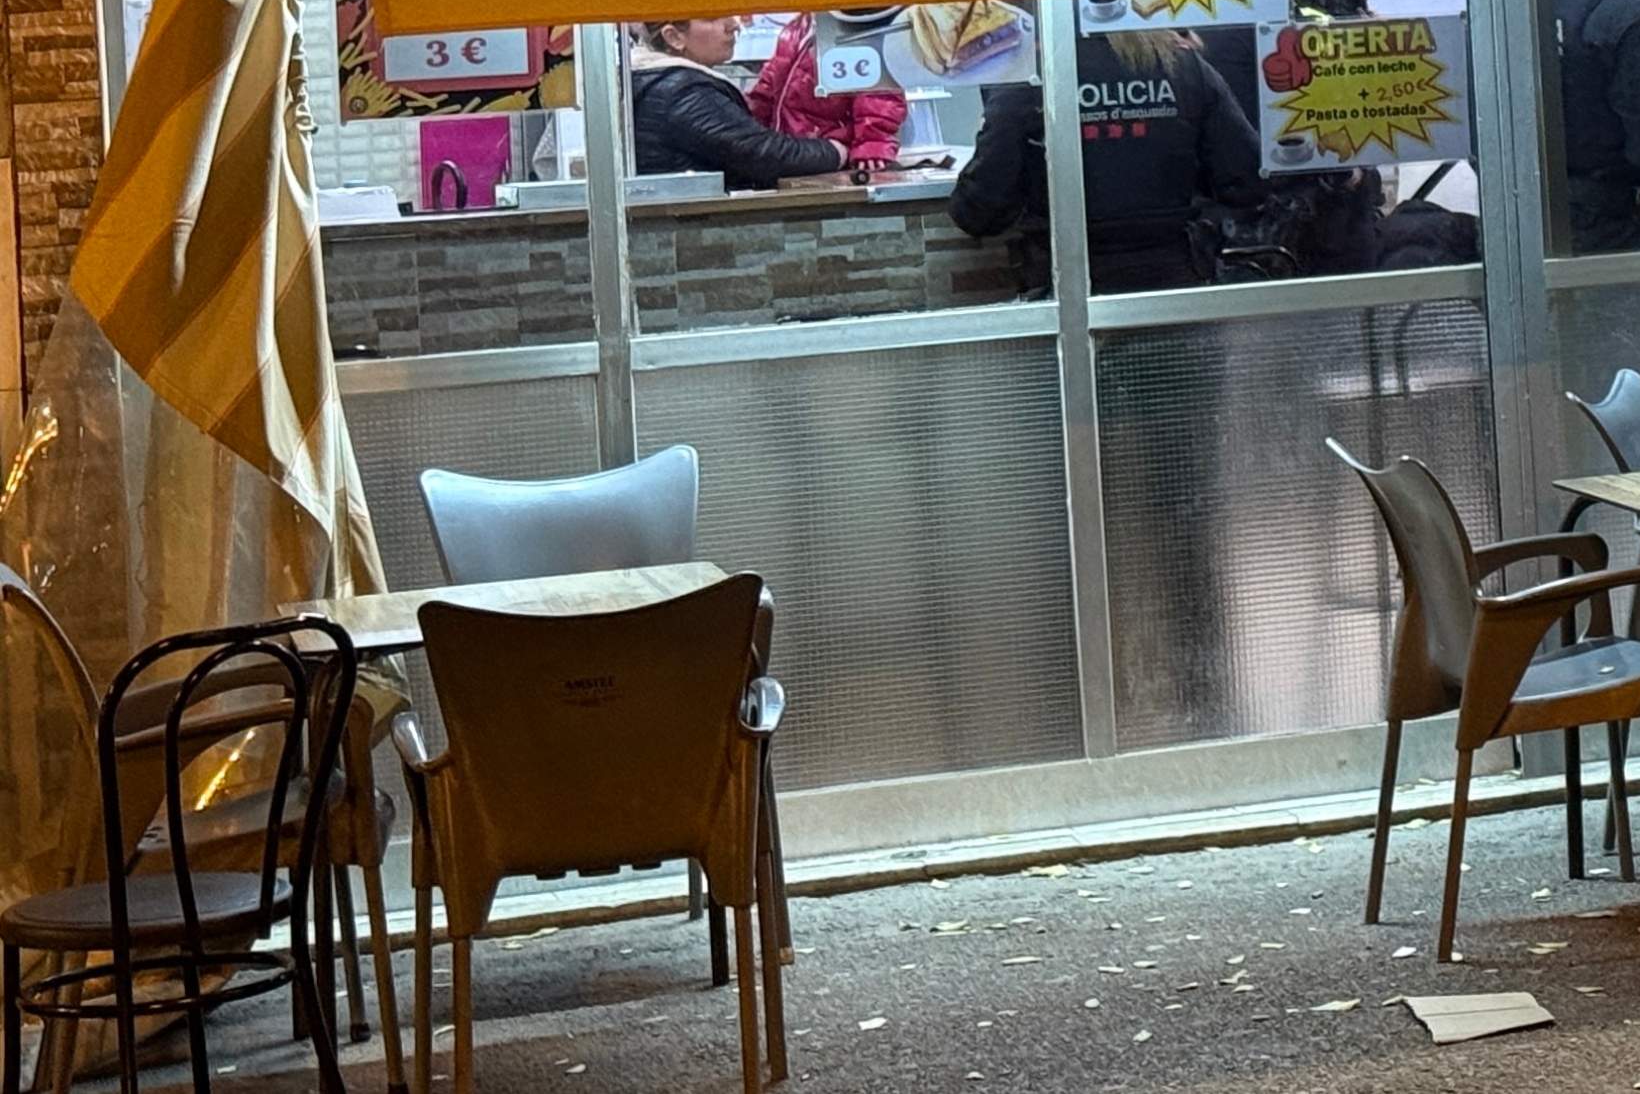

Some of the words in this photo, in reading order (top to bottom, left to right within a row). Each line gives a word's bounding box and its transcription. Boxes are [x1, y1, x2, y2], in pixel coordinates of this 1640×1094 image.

[1300, 21, 1434, 58] OFERTA
[425, 39, 450, 68] 3
[460, 37, 488, 65] €
[831, 60, 848, 80] 3
[853, 58, 871, 78] €
[1313, 63, 1346, 78] Café
[1348, 63, 1376, 76] con
[1377, 59, 1417, 74] leche
[1079, 79, 1177, 108] OLICIA
[1306, 107, 1348, 122] Pasta
[1350, 108, 1360, 119] o
[1362, 104, 1427, 119] tostadas
